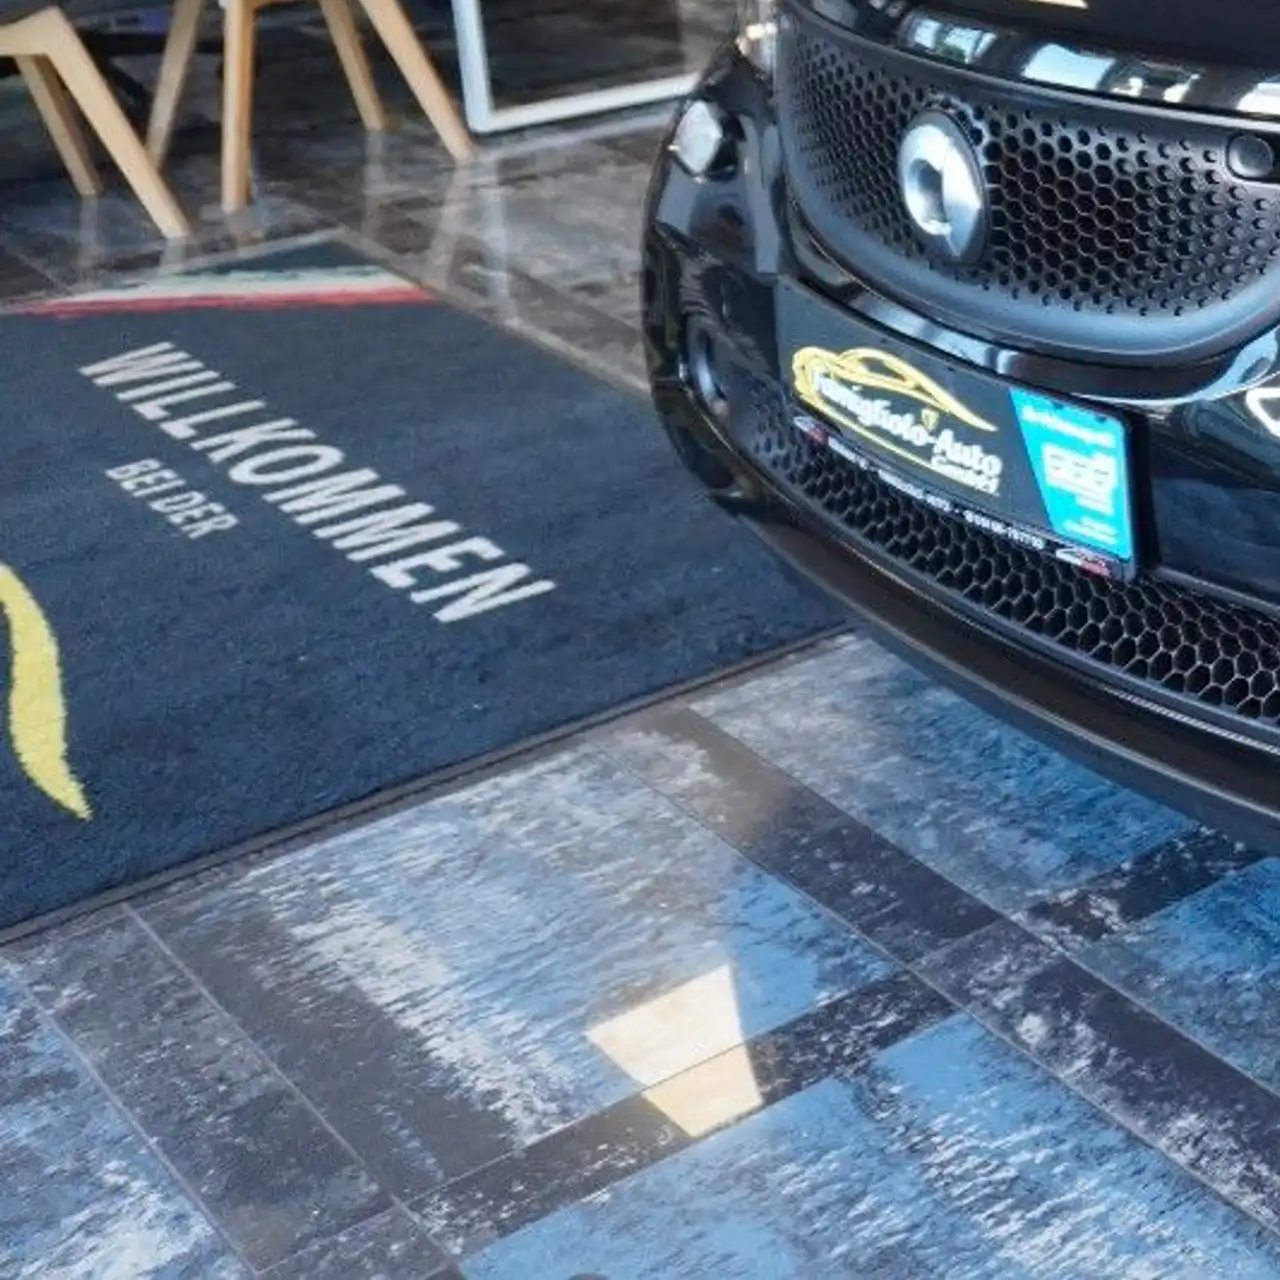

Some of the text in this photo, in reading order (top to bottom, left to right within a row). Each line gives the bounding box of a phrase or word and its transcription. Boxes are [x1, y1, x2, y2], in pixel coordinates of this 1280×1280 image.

[78, 341, 557, 623] WILLKOMMEN
[104, 458, 240, 540] BEI DER
